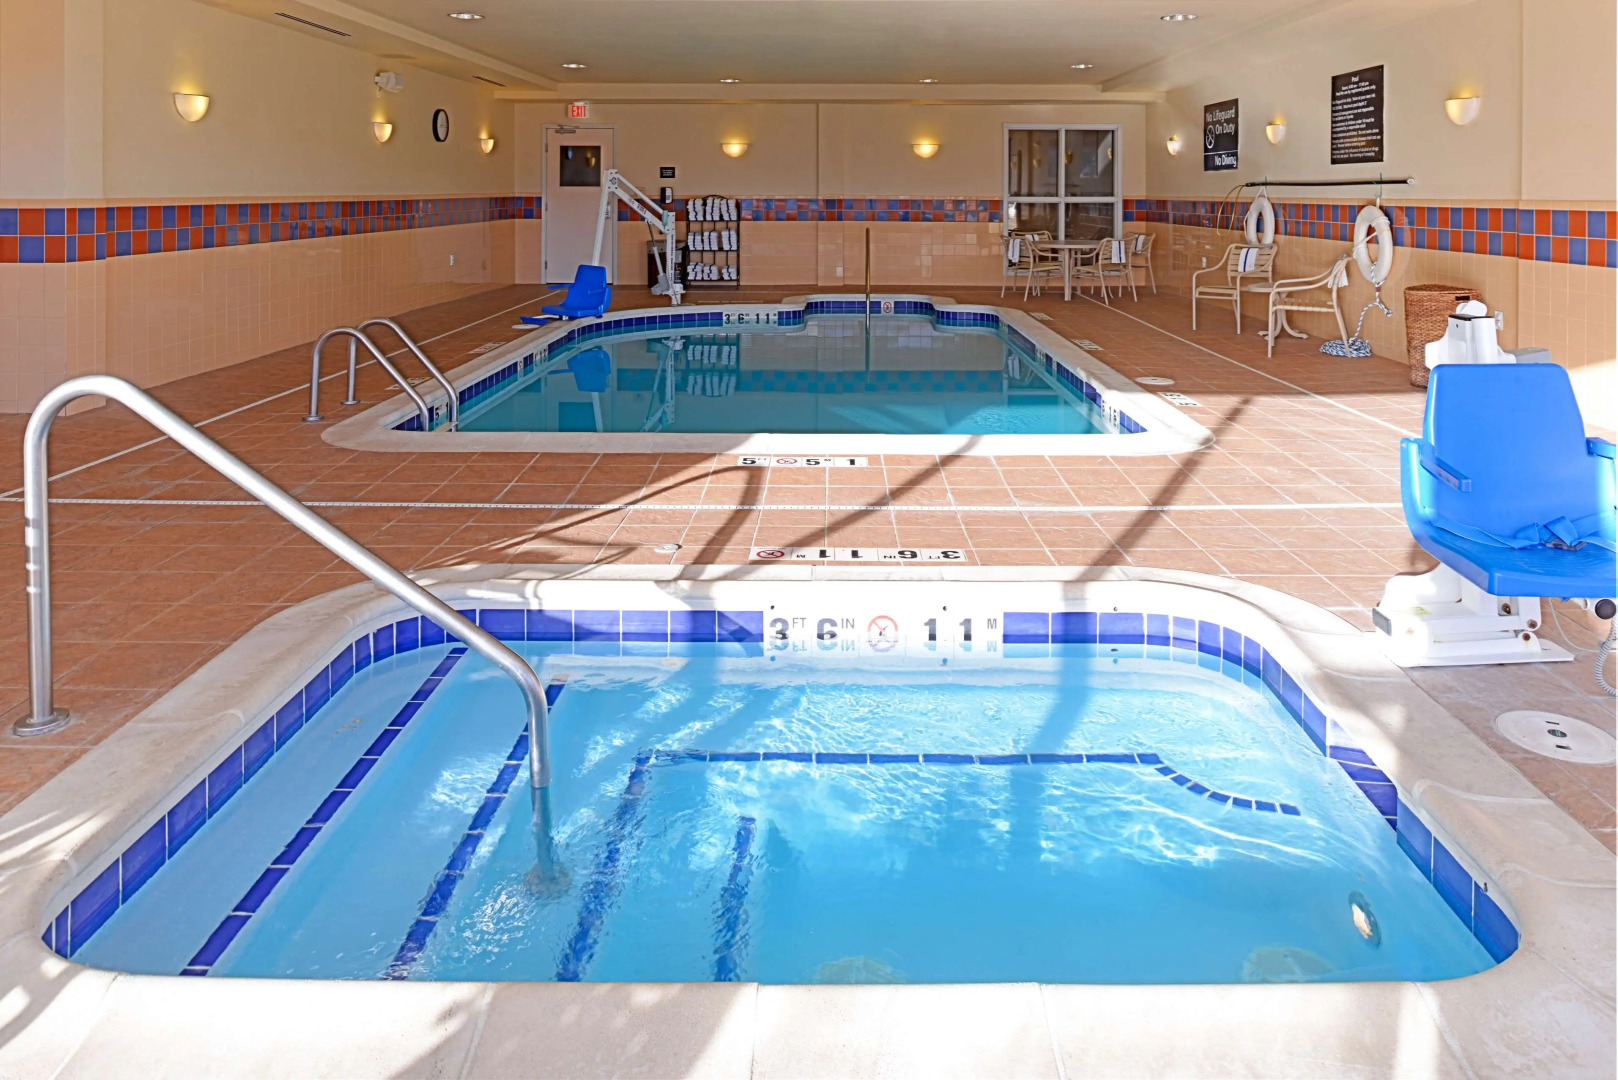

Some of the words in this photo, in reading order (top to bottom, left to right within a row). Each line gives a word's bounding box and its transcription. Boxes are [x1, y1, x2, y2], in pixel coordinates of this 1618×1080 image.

[571, 105, 587, 117] EXIT
[1206, 112, 1212, 122] No
[1213, 106, 1235, 122] Lifeguard
[1215, 124, 1222, 134] On
[1223, 123, 1235, 135] Duty
[1214, 155, 1221, 166] No
[1222, 154, 1236, 167] Diving
[898, 550, 918, 559] 6
[940, 550, 961, 559] 3
[769, 618, 789, 640] 3
[792, 618, 806, 629] FT
[817, 618, 838, 640] 6
[841, 618, 855, 629] IN
[987, 618, 997, 629] M
